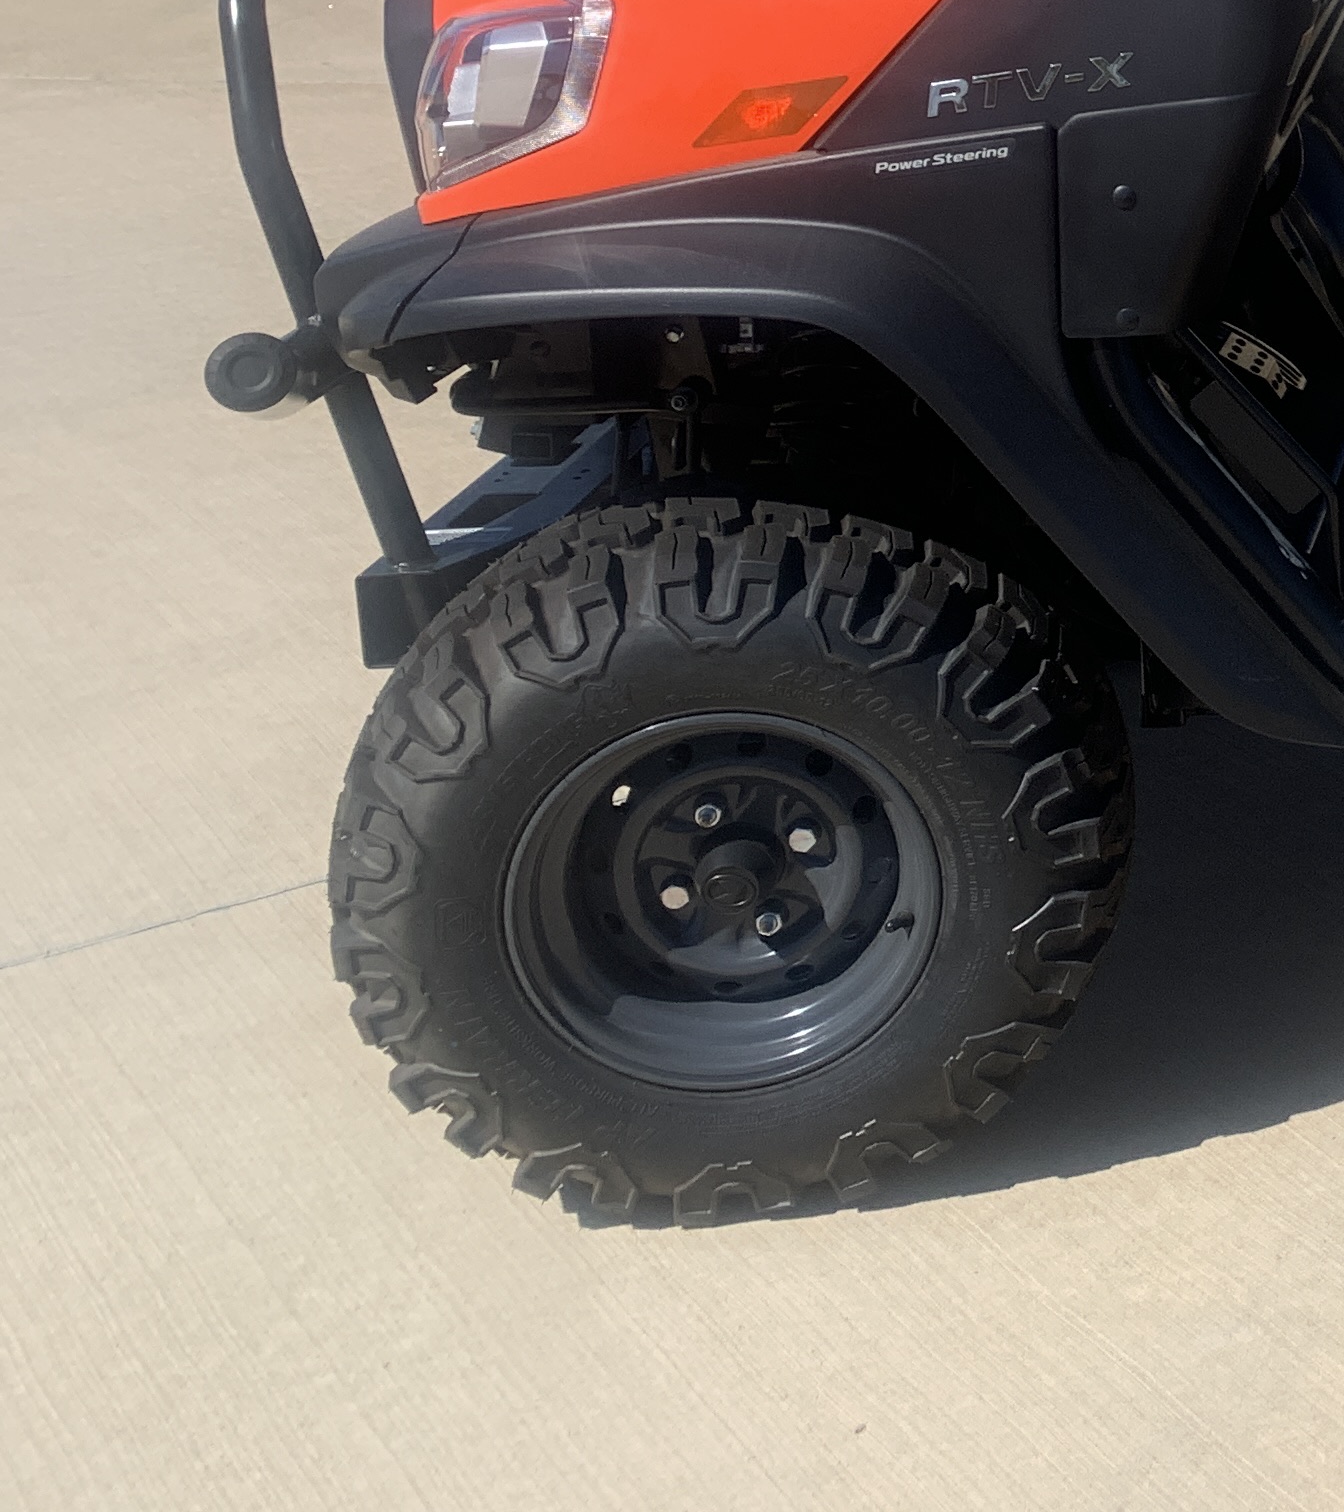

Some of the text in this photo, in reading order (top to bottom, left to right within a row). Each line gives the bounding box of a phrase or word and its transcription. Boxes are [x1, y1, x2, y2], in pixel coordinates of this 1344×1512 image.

[926, 51, 1133, 119] RTV-X
[875, 145, 1008, 174] Power Steering
